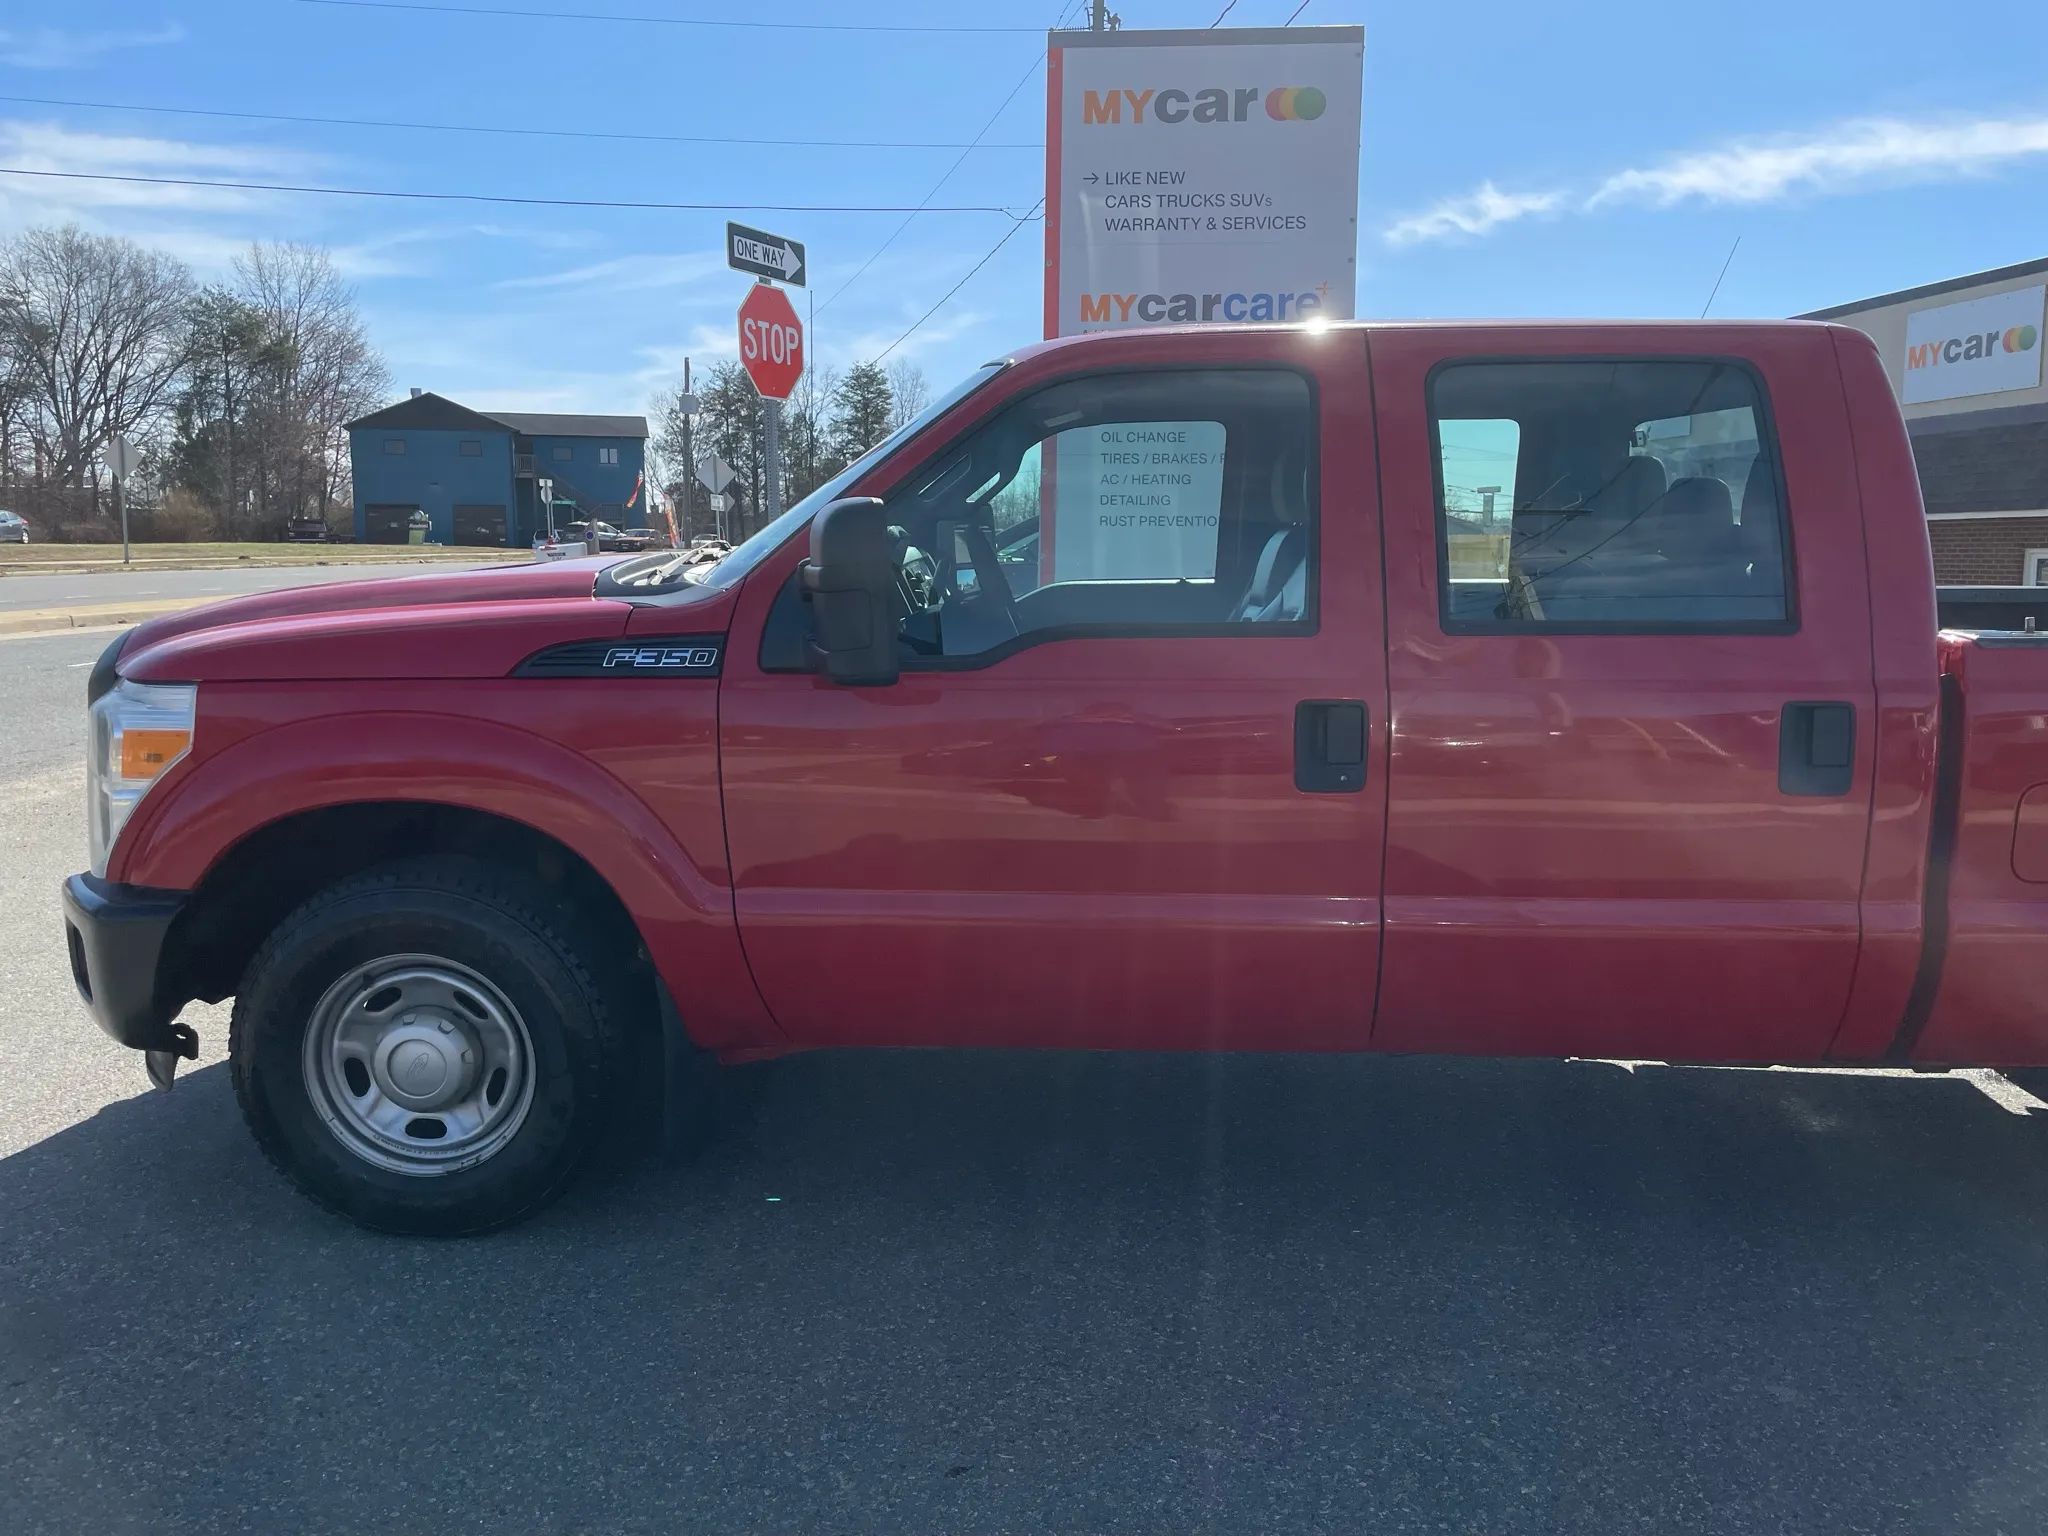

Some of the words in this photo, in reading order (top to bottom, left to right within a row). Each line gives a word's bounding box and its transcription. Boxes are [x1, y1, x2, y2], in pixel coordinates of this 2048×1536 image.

[1082, 87, 1259, 125] MYcar
[1105, 172, 1142, 185] LIKE
[1146, 171, 1186, 185] NEW
[1105, 194, 1152, 208] CARS
[1156, 193, 1226, 208] TRUCKS
[1230, 193, 1273, 207] SUVs
[1104, 216, 1202, 231] WARRANTY
[1206, 216, 1218, 231] &
[1222, 215, 1307, 230] SERVICES
[736, 238, 759, 261] ONE
[761, 246, 785, 267] WAY
[743, 317, 799, 366] STOP
[1908, 330, 1999, 370] MYcar
[1101, 431, 1123, 443] OIL
[1126, 431, 1186, 443] CHANGE
[1100, 453, 1140, 465] TIRES
[1143, 453, 1149, 465] /
[1152, 453, 1208, 465] BRAKES
[1100, 474, 1119, 485] AC
[1121, 474, 1128, 485] /
[1131, 474, 1192, 485] HEATING
[1100, 494, 1171, 506] DETAILING
[1100, 515, 1135, 527] RUST
[1139, 515, 1218, 527] PREVENTIO
